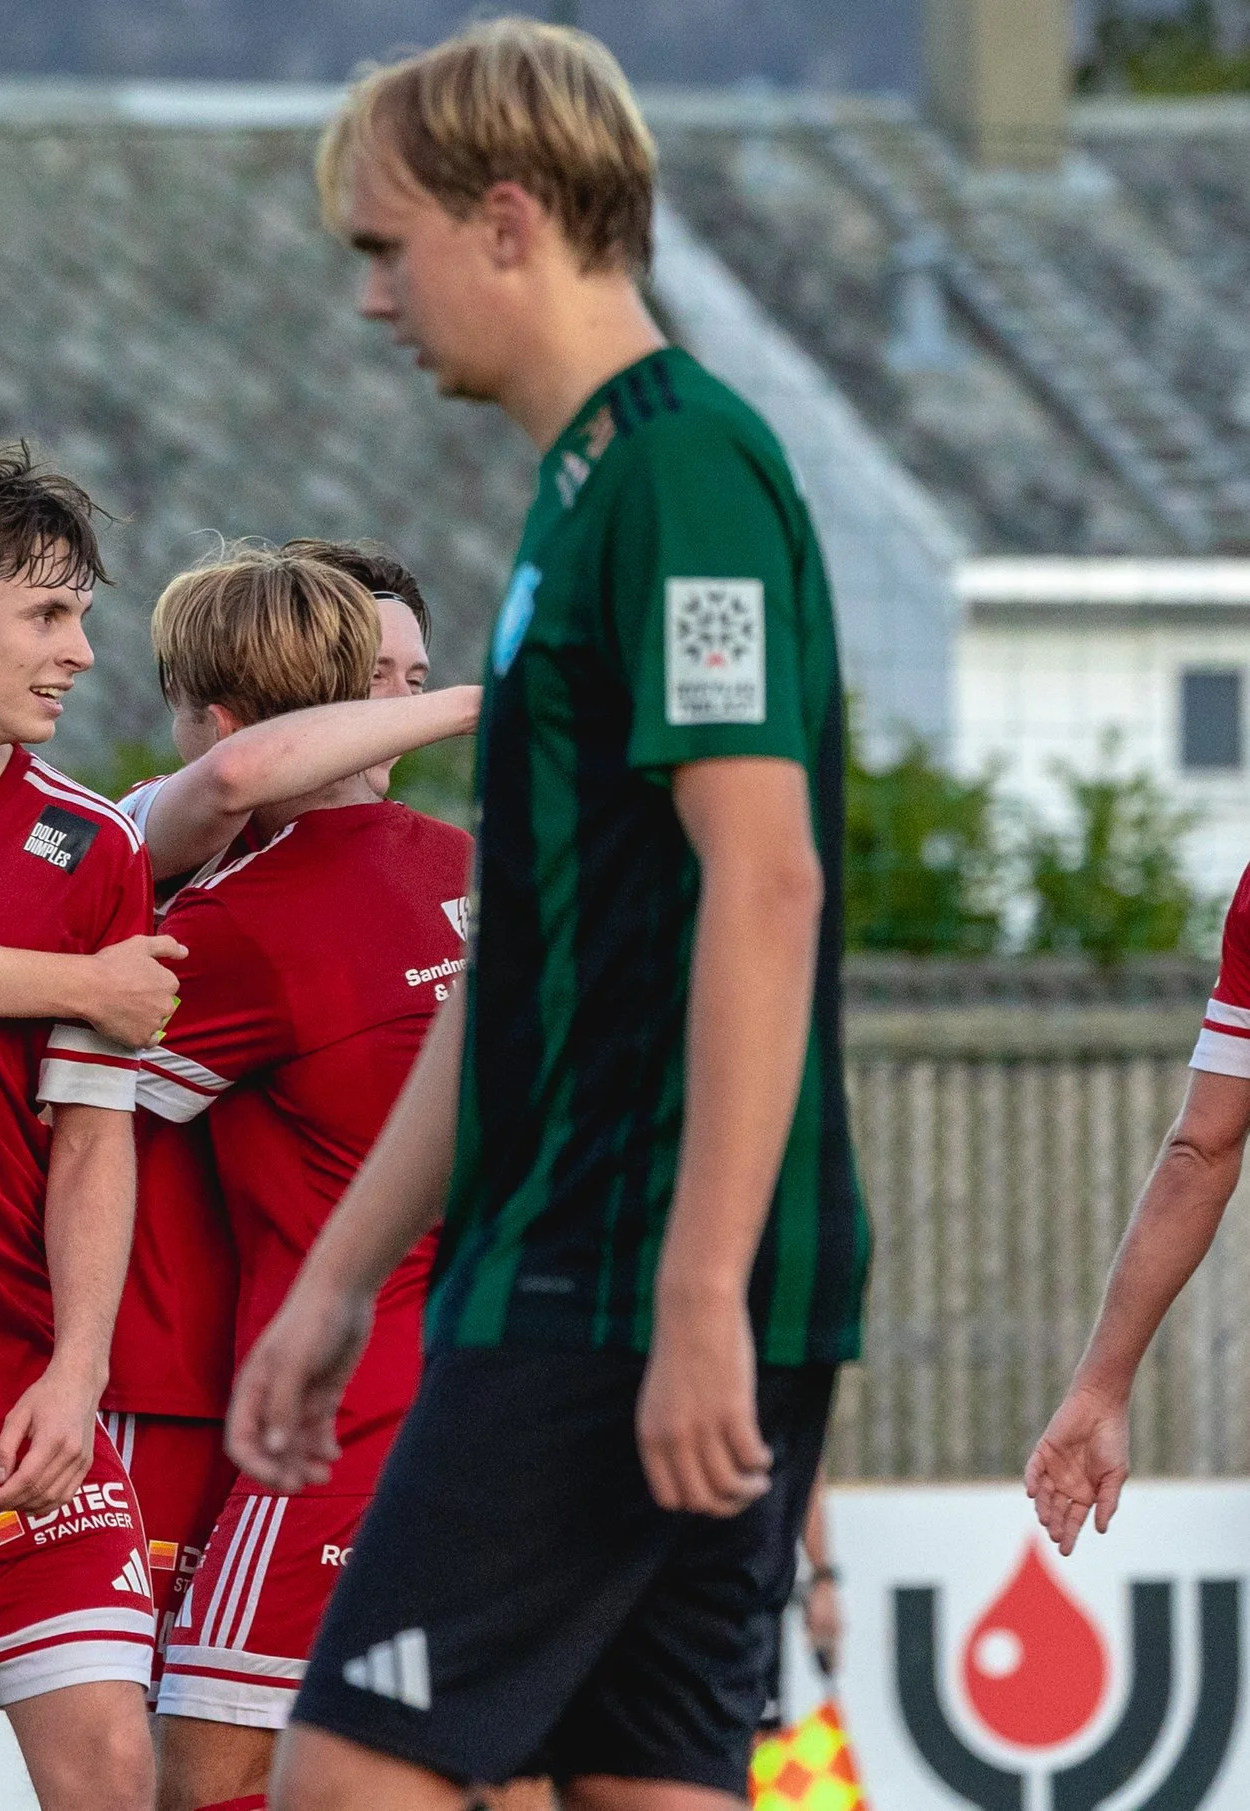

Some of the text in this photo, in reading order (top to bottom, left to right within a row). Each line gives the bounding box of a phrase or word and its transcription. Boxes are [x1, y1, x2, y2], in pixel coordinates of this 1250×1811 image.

[31, 822, 67, 847] DOLLY
[23, 836, 71, 868] DIMPLES
[404, 957, 468, 987] Sandne
[434, 983, 450, 1001] &
[33, 1512, 134, 1545] STAVANGER
